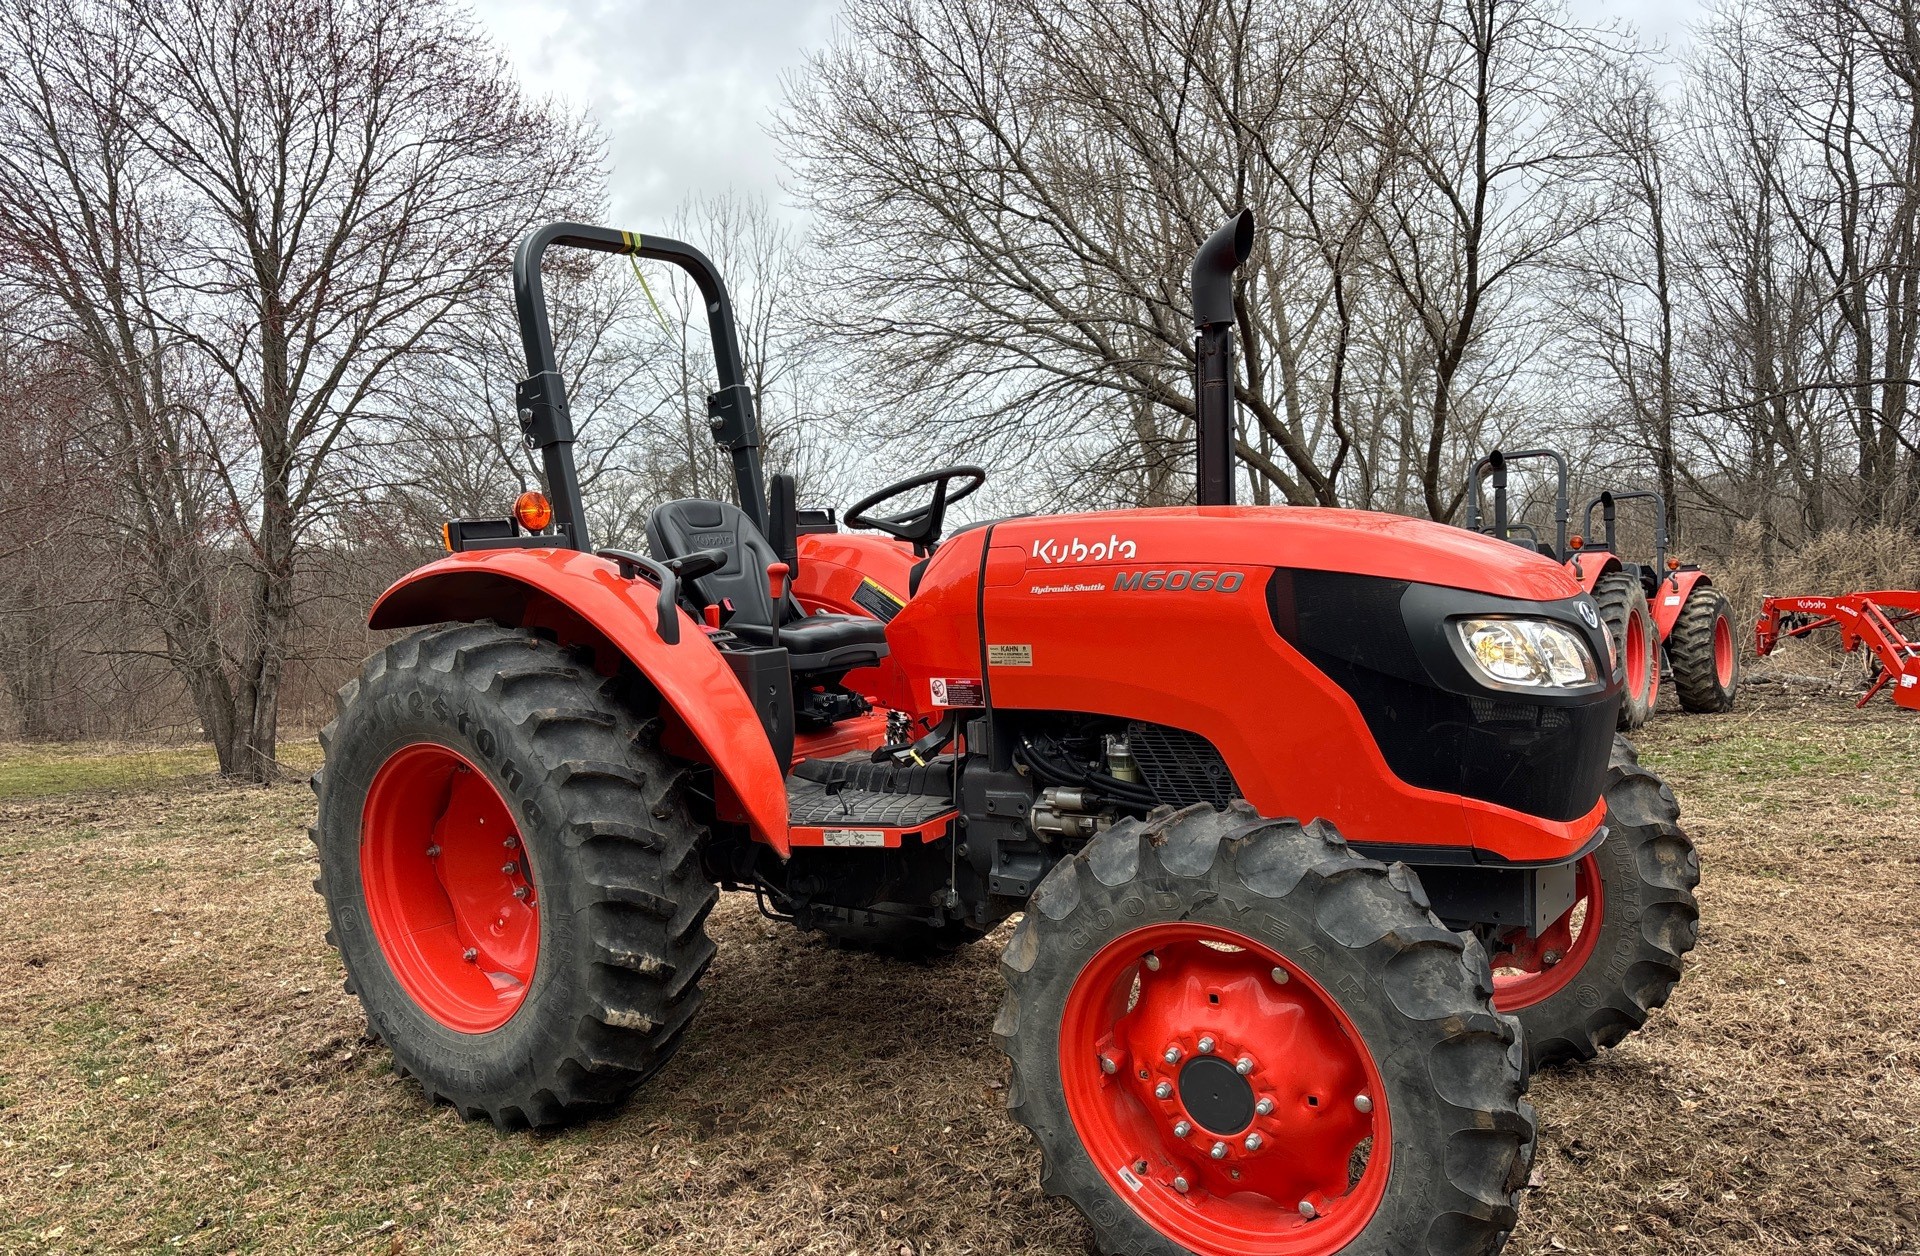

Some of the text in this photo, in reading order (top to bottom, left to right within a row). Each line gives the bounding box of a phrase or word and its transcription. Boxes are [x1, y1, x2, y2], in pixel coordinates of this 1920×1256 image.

[693, 533, 733, 546] Kubota
[1032, 534, 1137, 564] Kubota
[1030, 582, 1105, 595] Hydraulic Shuttle
[1113, 569, 1245, 592] M6060
[1797, 599, 1827, 609] Kubota
[1067, 889, 1369, 1006] GOODYEAR
